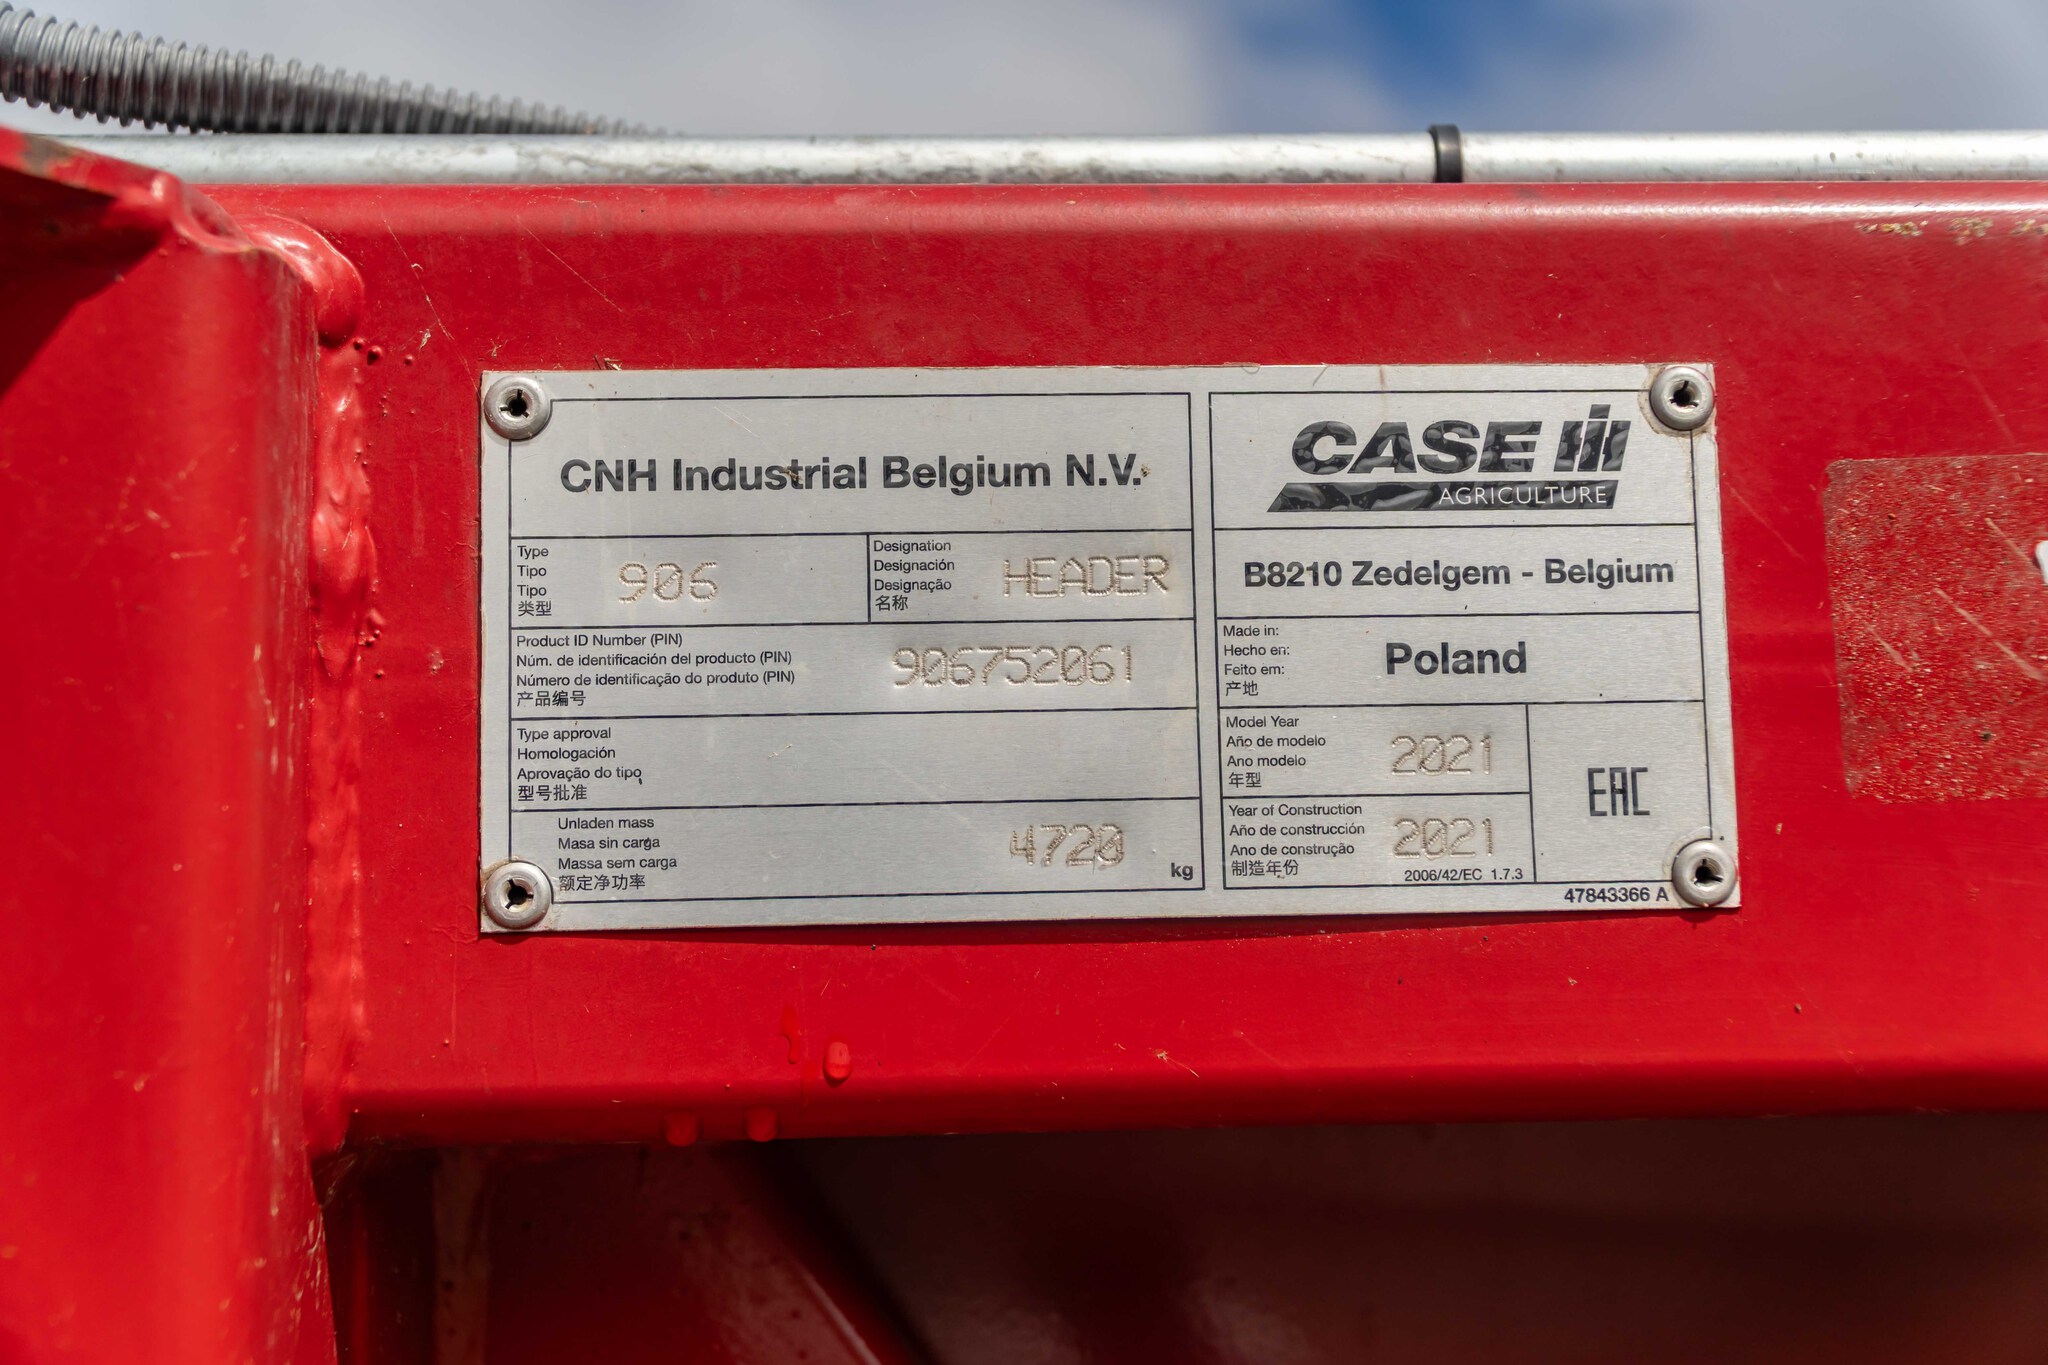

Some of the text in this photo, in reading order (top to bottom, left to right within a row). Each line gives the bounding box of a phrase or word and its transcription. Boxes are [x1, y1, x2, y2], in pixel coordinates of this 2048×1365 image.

[1292, 421, 1543, 474] CASE
[561, 453, 1143, 496] CNH Industrial Belgium N.V.
[1438, 486, 1607, 505] AGRICULTURE
[517, 545, 549, 560] Type
[874, 540, 951, 554] Designation
[517, 565, 546, 579] Tipo
[874, 559, 954, 574] Designación
[1245, 561, 1342, 587] B8210
[1352, 560, 1510, 591] Zedelgem
[1545, 558, 1674, 590] Belgium
[618, 561, 719, 603] 906
[1003, 555, 1170, 598] HEADER
[517, 585, 547, 599] Tipo
[875, 579, 951, 595] Designação
[518, 598, 552, 616] 类型
[875, 593, 910, 611] 名称
[1223, 625, 1279, 636] Made in:
[517, 633, 682, 648] Product ID Number (PIN)
[1224, 644, 1289, 656] Hecho en:
[1386, 641, 1526, 675] Poland
[517, 651, 791, 667] Núm. de identificación del producto (PIN)
[892, 645, 1131, 688] 906752061
[1224, 664, 1284, 675] Feito em:
[517, 670, 795, 687] Número de identificação do produto (PIN)
[1226, 680, 1258, 696] 产地
[517, 690, 586, 707] 产品编号
[1226, 716, 1299, 728] Model Year
[517, 727, 611, 743] Type approval
[1226, 735, 1326, 749] Año de modelo
[518, 746, 615, 762] Homologación
[1227, 754, 1306, 767] Ano modelo
[1391, 734, 1492, 776] 2021
[517, 766, 642, 784] Aprovação do tipo
[1229, 772, 1262, 788] 年型
[518, 784, 587, 801] 型号批准
[1229, 804, 1362, 816] Year of Construction
[558, 817, 654, 830] Unladen mass
[1229, 822, 1364, 836] Año de construcción
[559, 837, 660, 851] Masa sin carga
[1009, 823, 1125, 867] 4720
[1394, 817, 1494, 860] 2021
[1230, 843, 1354, 857] Ano de construção
[559, 858, 677, 870] Massa sem carga
[1171, 862, 1193, 881] kg
[1231, 859, 1299, 879] 制造年份
[557, 873, 645, 894] 额定净功率
[1404, 868, 1525, 883] 2006/42/EC 1.7.3
[1564, 887, 1669, 903] 47843366 A
